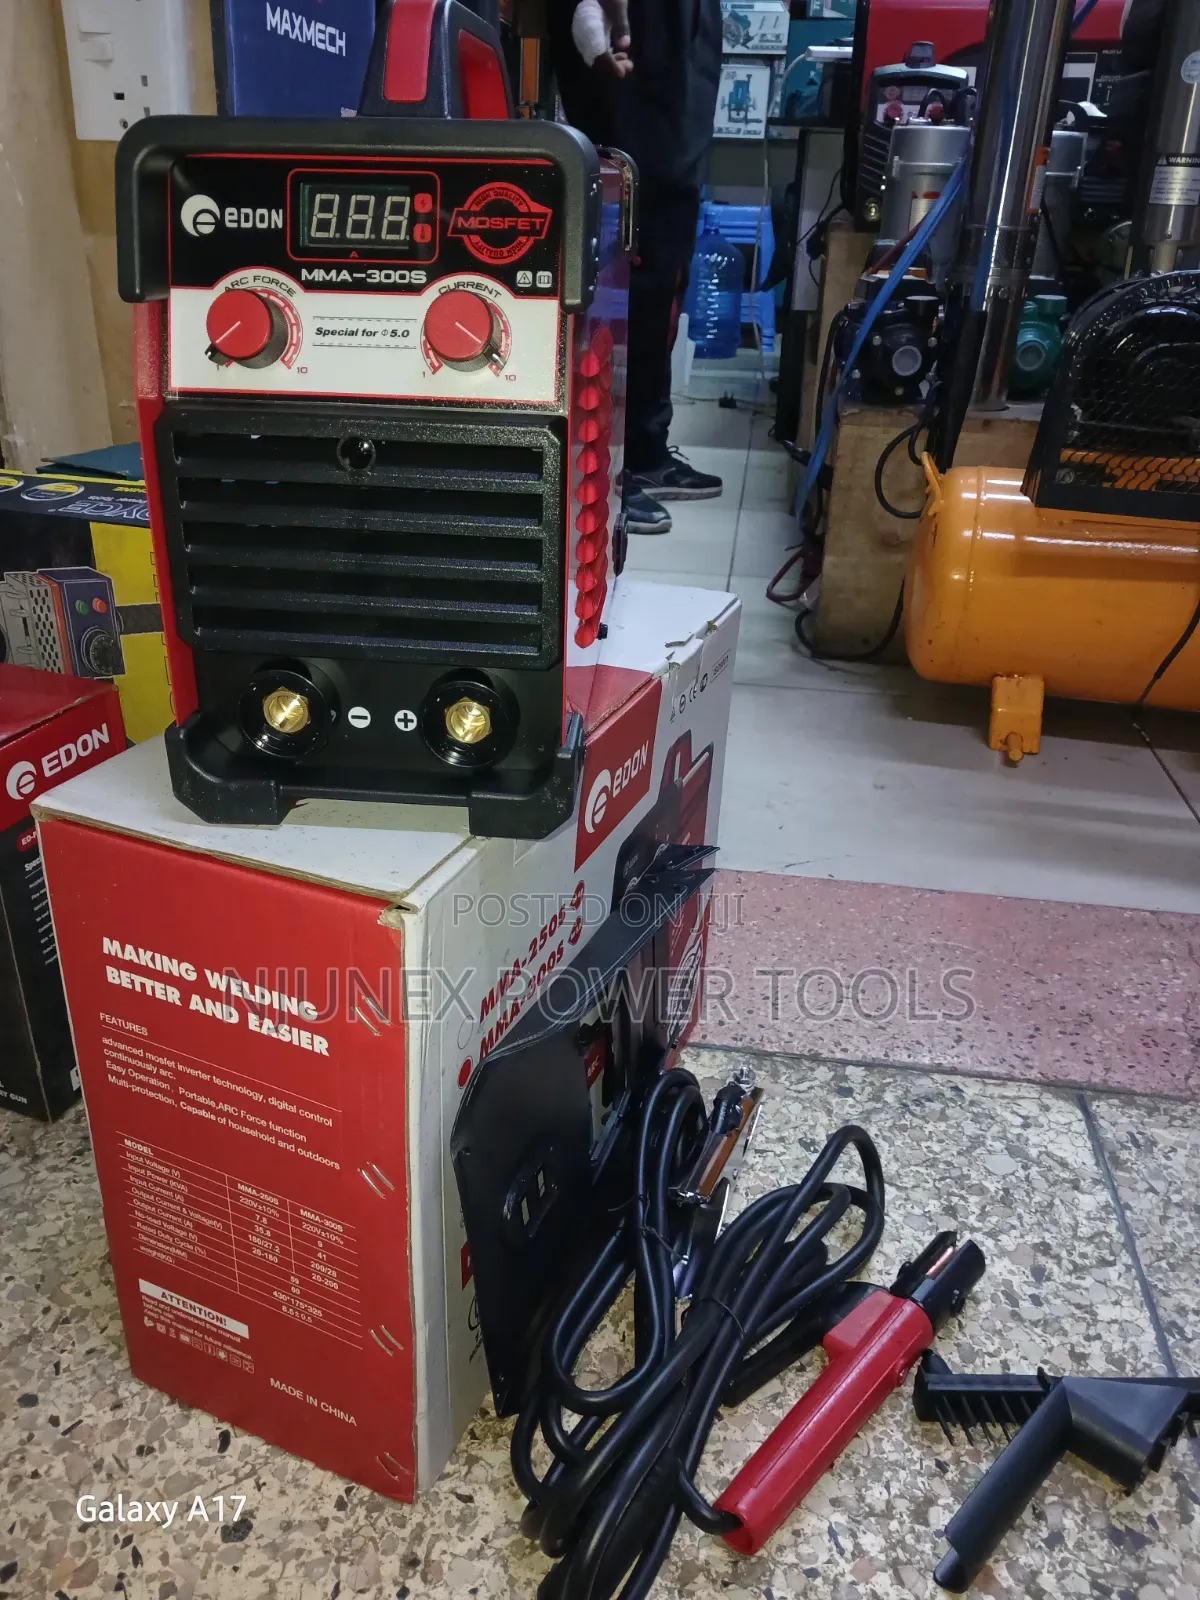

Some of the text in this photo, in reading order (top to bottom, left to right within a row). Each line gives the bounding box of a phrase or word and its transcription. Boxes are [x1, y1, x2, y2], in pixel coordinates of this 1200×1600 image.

[266, 2, 346, 57] MAXMECH
[475, 188, 523, 207] HIGH QUALITY
[457, 216, 545, 230] MOSFET
[224, 275, 297, 298] ARC FORCE
[301, 269, 427, 283] MMA-300S
[438, 281, 502, 299] CURRENT
[315, 327, 358, 338] Special
[361, 328, 379, 337] for
[297, 366, 308, 374] 10
[42, 723, 110, 778] EDON
[479, 903, 566, 1024] MMA-250S
[102, 936, 318, 1022] MAKING WELDING
[100, 1012, 149, 1036] FEATURES
[105, 965, 330, 1057] BETTER AND EASIER
[103, 1047, 177, 1081] continuously arc.
[102, 1036, 334, 1128] advanced mosfet inverter technology, digital control
[105, 1060, 127, 1078] Easy
[240, 1106, 267, 1128] Force
[268, 1120, 308, 1144] function
[107, 1073, 179, 1108] Multi-protection,
[179, 1100, 217, 1122] Capable
[217, 1115, 228, 1126] of
[228, 1117, 277, 1146] household
[277, 1135, 296, 1154] and
[297, 1145, 341, 1170] outdoors
[123, 1138, 154, 1156] MODEL
[126, 1150, 181, 1179] Input Voltage (V)
[127, 1163, 145, 1176] Input
[146, 1169, 169, 1184] Power
[129, 1174, 147, 1187] Input
[148, 1182, 174, 1198] Current
[131, 1186, 155, 1202] Output
[155, 1196, 181, 1212] Current
[237, 1182, 280, 1206] MMA-250S
[132, 1197, 156, 1213] Output
[157, 1207, 182, 1224] Current
[134, 1209, 161, 1226] No-load
[162, 1220, 188, 1238] Voltage
[299, 1208, 344, 1233] MMA-300S
[136, 1221, 157, 1235] Rated
[157, 1229, 174, 1244] Duty
[174, 1236, 195, 1251] Cycle
[317, 1252, 327, 1262] 41
[141, 1294, 241, 1344] Read and understand this manual
[161, 1290, 228, 1328] ATTENTION!
[160, 1314, 172, 1325] this
[171, 1320, 195, 1336] manual
[194, 1329, 204, 1339] for
[269, 1376, 358, 1428] MADE IN CHINA
